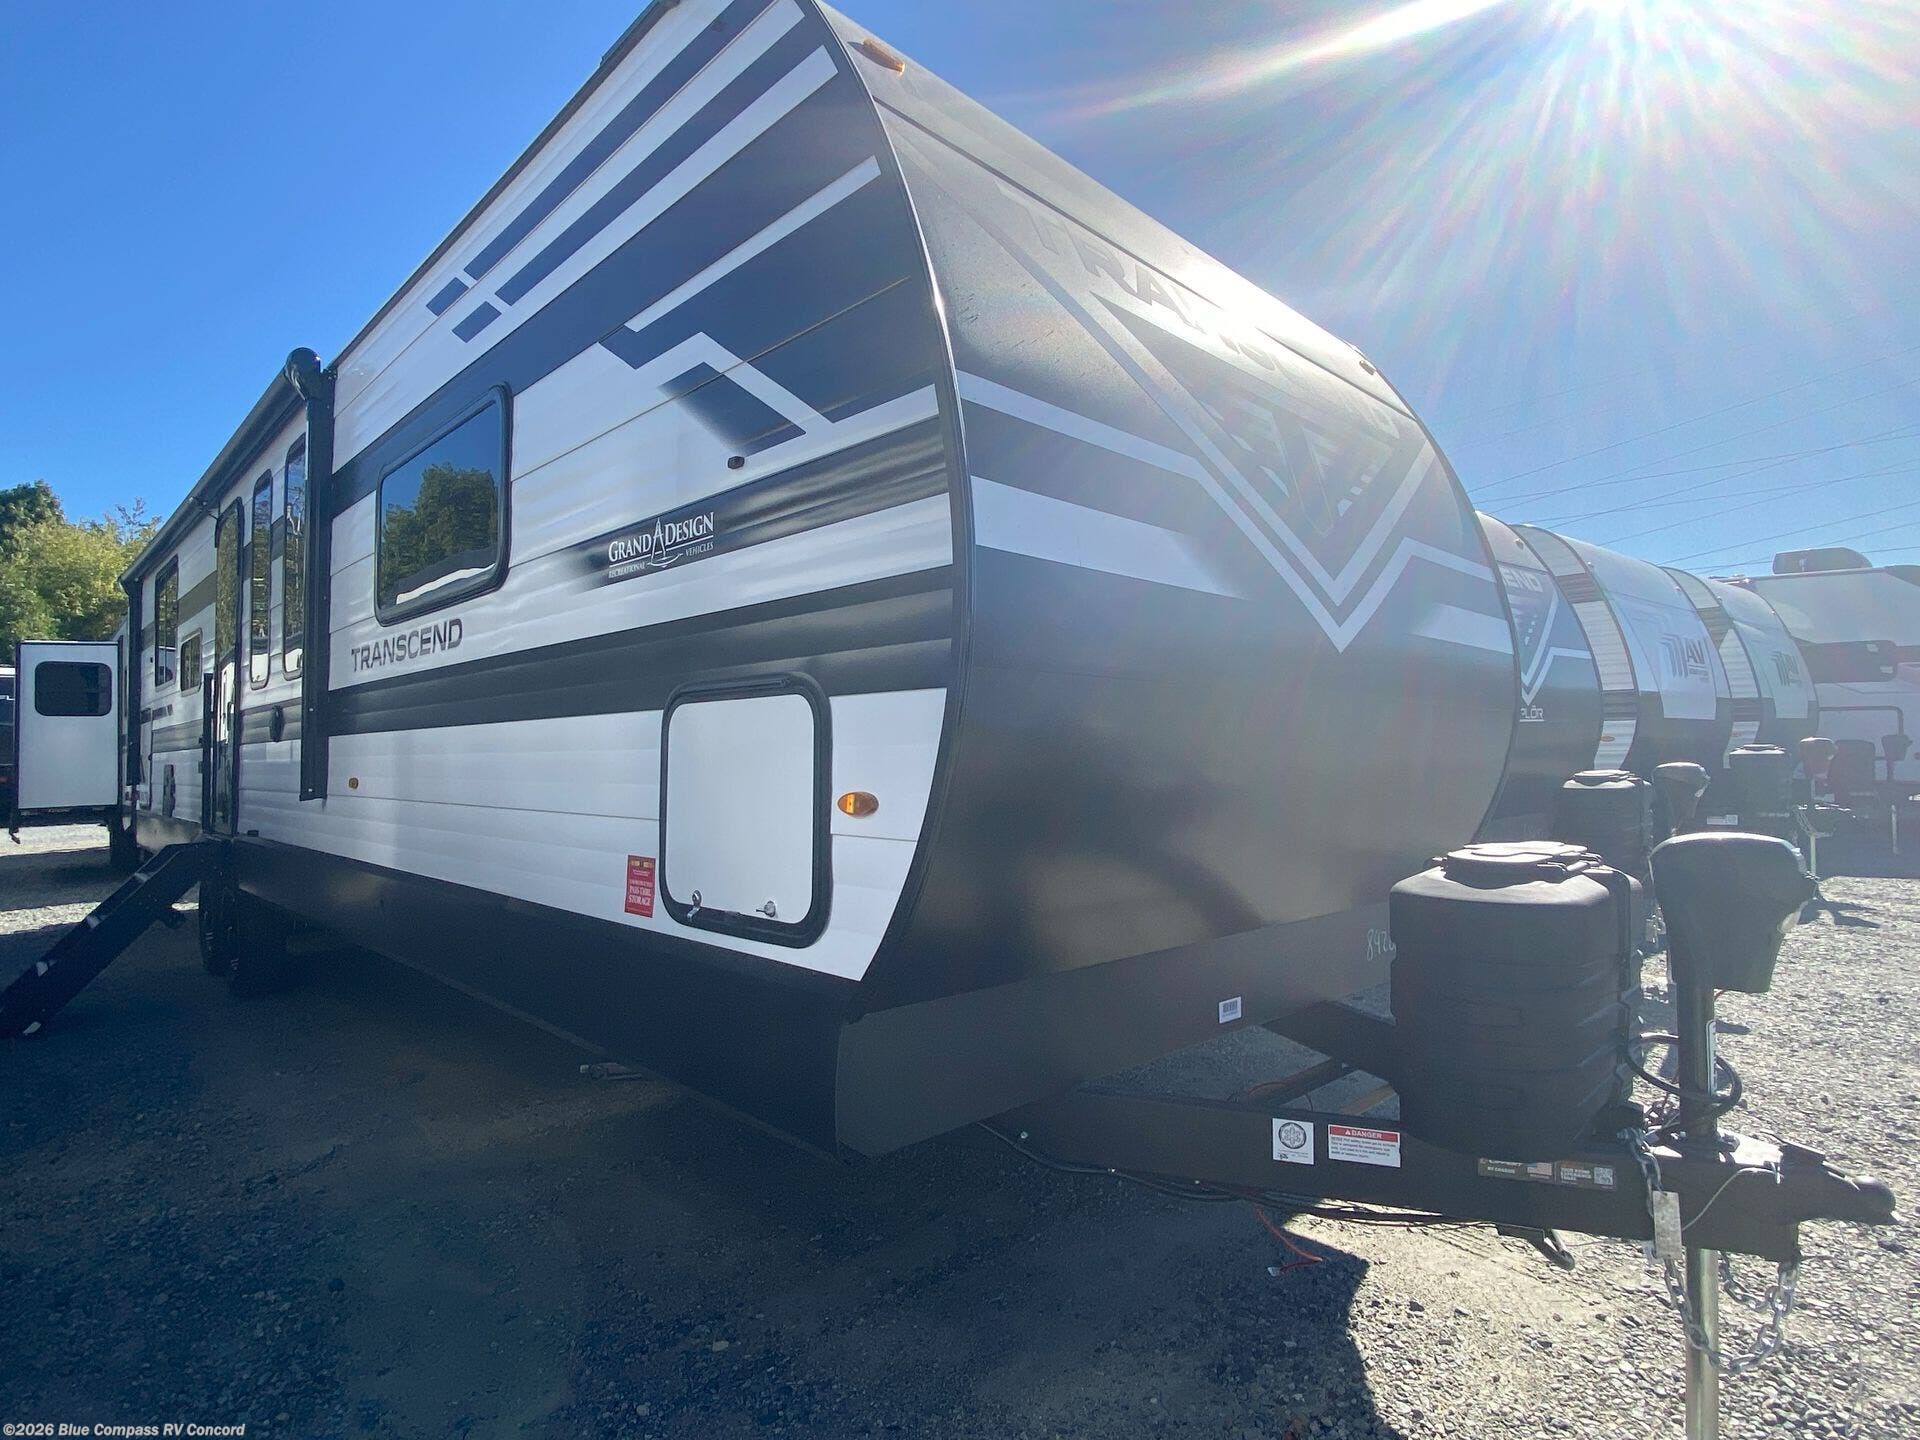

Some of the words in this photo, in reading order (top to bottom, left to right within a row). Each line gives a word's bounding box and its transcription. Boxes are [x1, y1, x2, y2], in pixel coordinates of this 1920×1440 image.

[608, 533, 651, 562] GRAND
[664, 511, 714, 546] DESIGN
[685, 541, 714, 557] VEHICLES
[351, 618, 463, 672] TRANSCEND
[1351, 1130, 1383, 1139] DANGER
